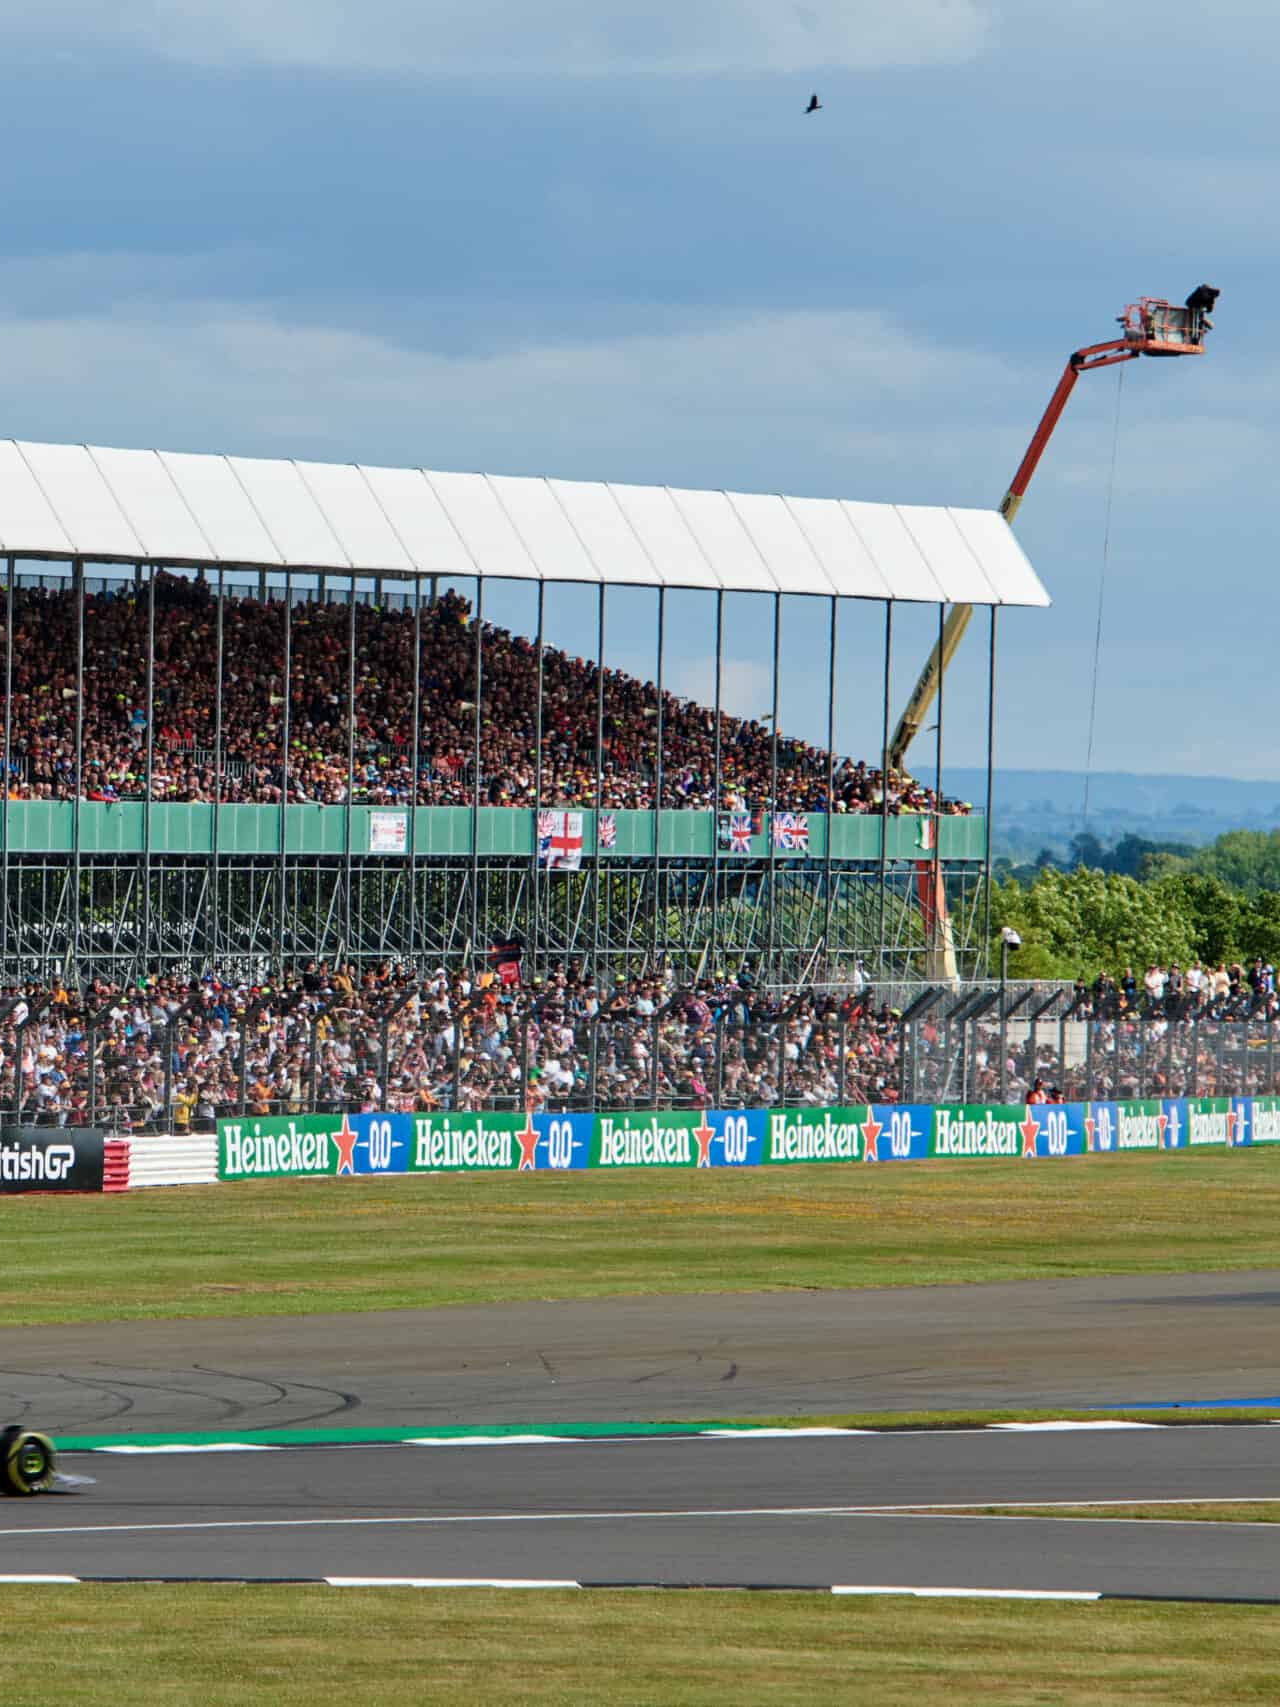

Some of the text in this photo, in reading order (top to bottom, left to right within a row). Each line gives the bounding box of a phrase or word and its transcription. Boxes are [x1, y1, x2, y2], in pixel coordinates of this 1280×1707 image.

[223, 1122, 329, 1174] Heineken
[415, 1118, 512, 1167] Heineken
[599, 1117, 691, 1165] Heineken
[770, 1113, 859, 1160] Heineken
[935, 1109, 1018, 1154] Heineken
